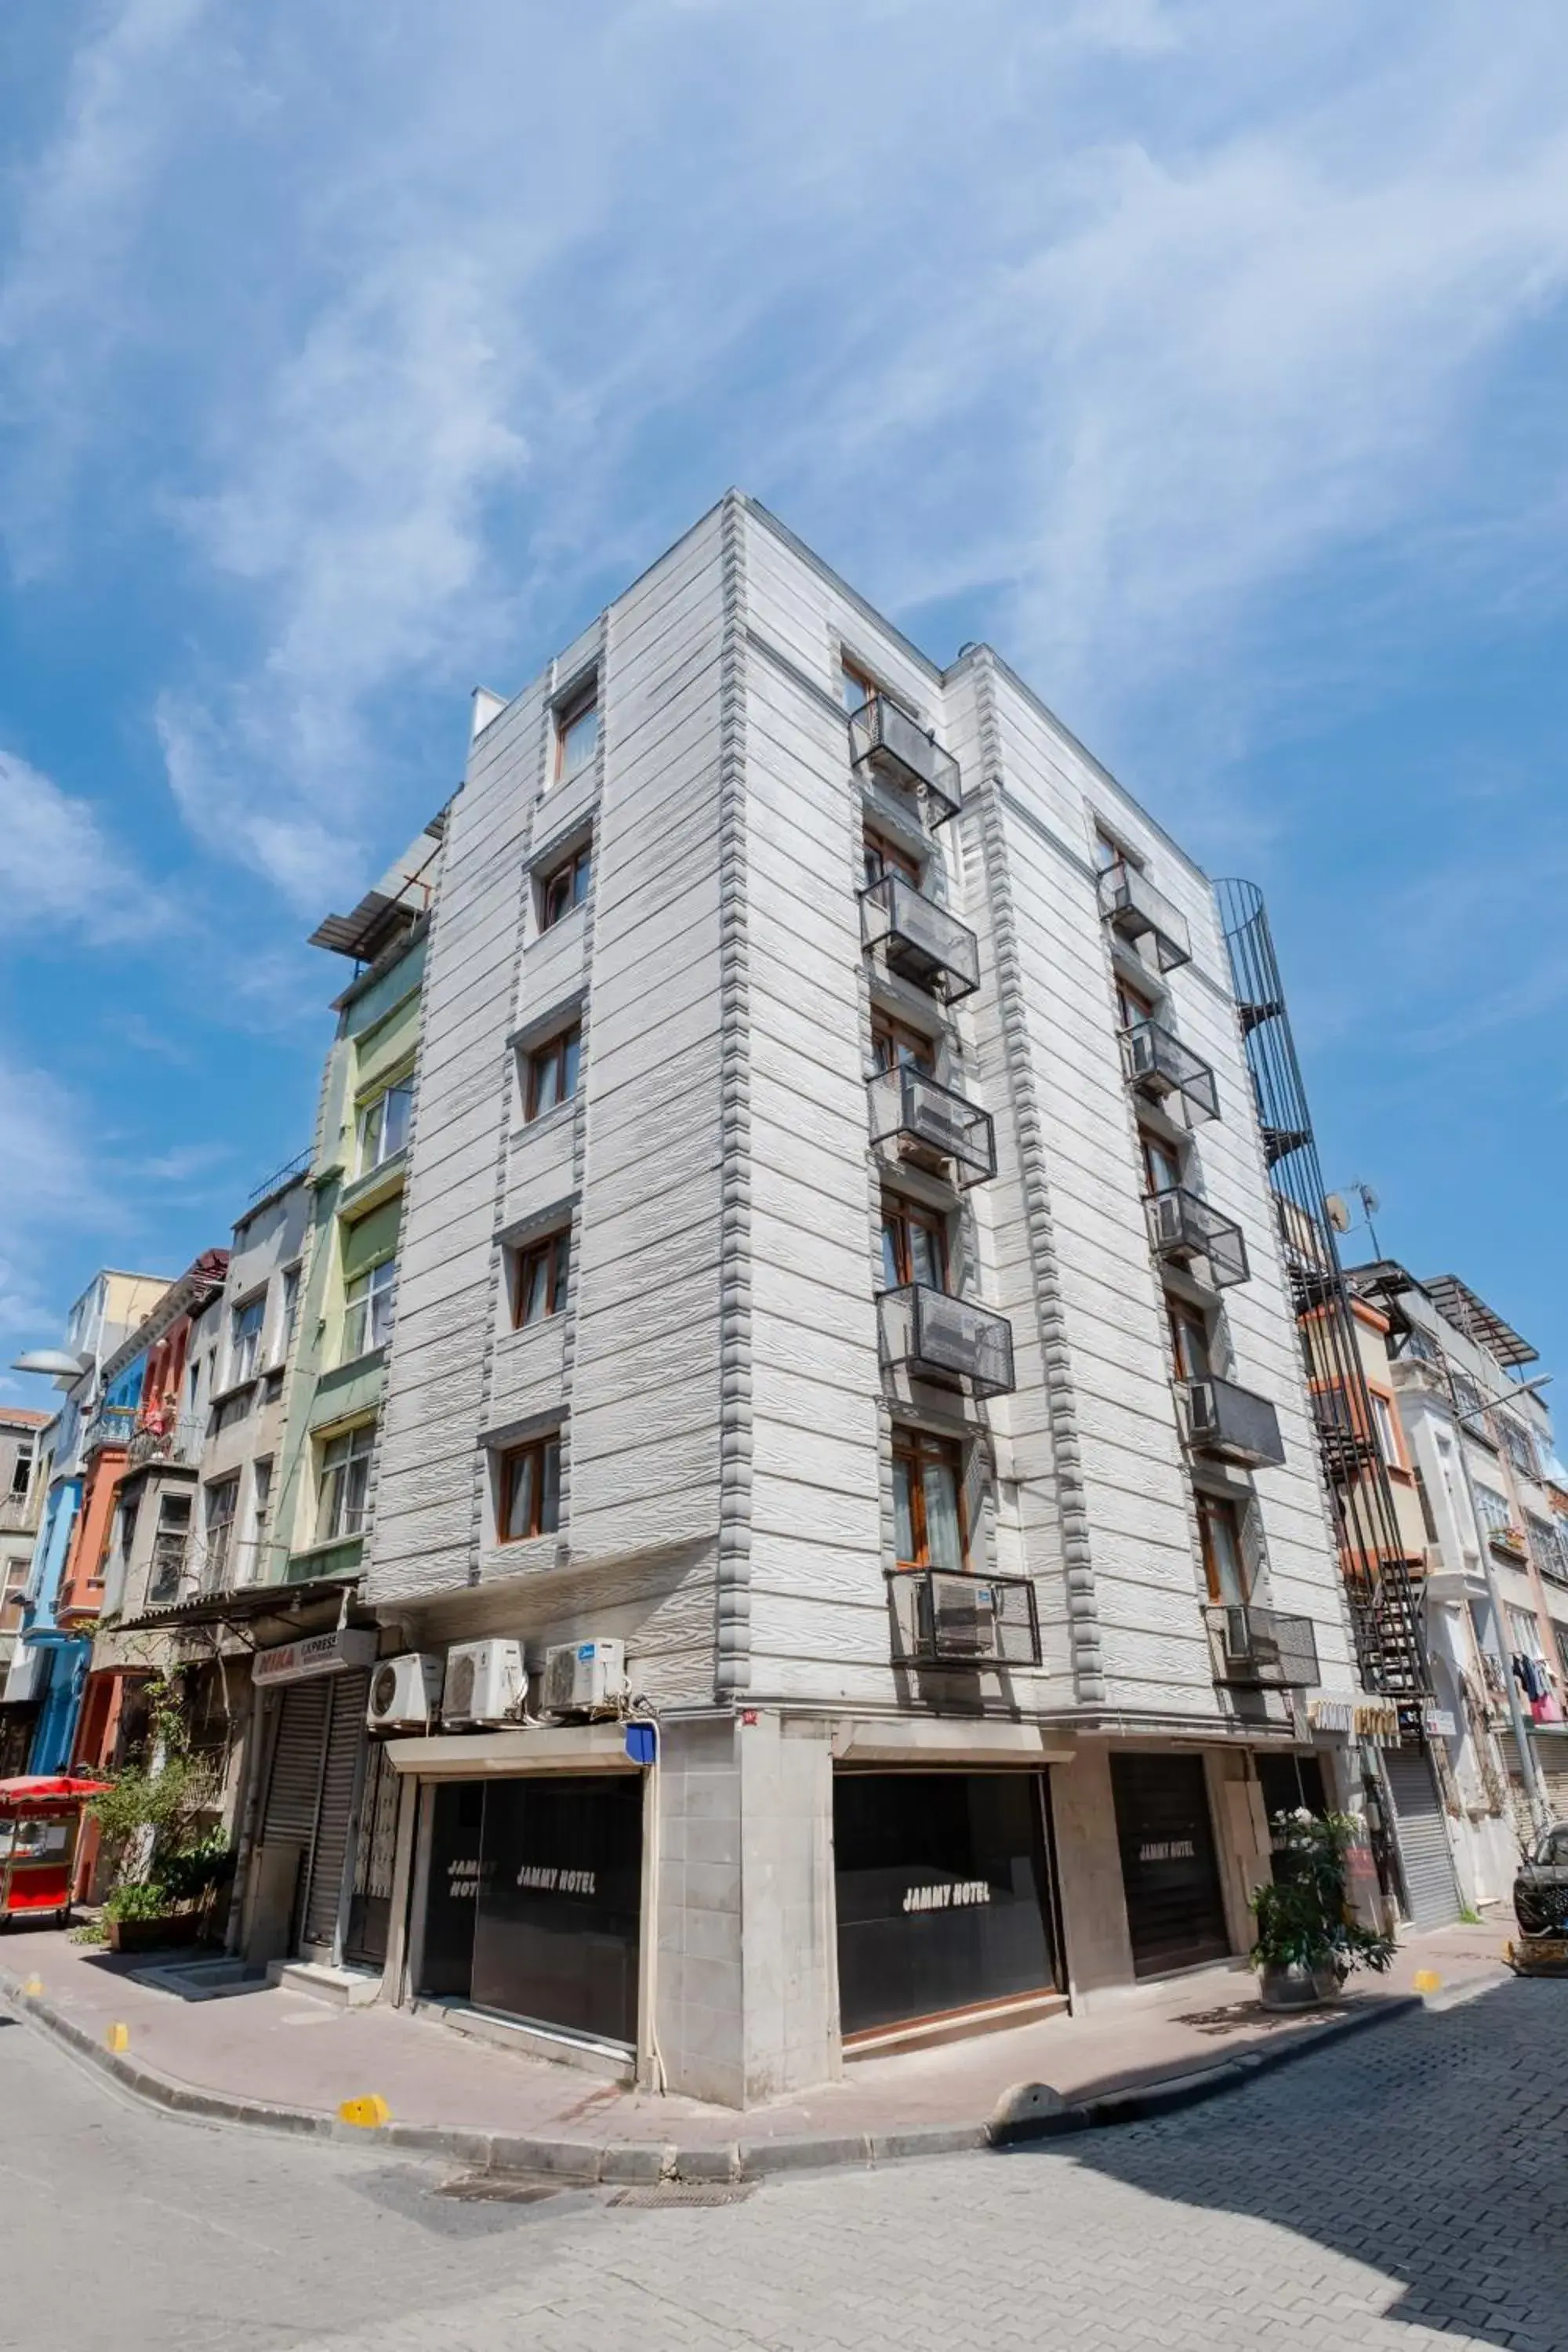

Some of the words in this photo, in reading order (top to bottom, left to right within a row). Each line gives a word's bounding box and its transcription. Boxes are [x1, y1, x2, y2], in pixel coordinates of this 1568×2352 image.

[449, 1881, 491, 1897] HOT
[517, 1864, 557, 1890] JAMMY
[559, 1869, 596, 1895] HOTEL
[903, 1884, 951, 1911] JAMMY
[953, 1881, 990, 1906] HOTEL
